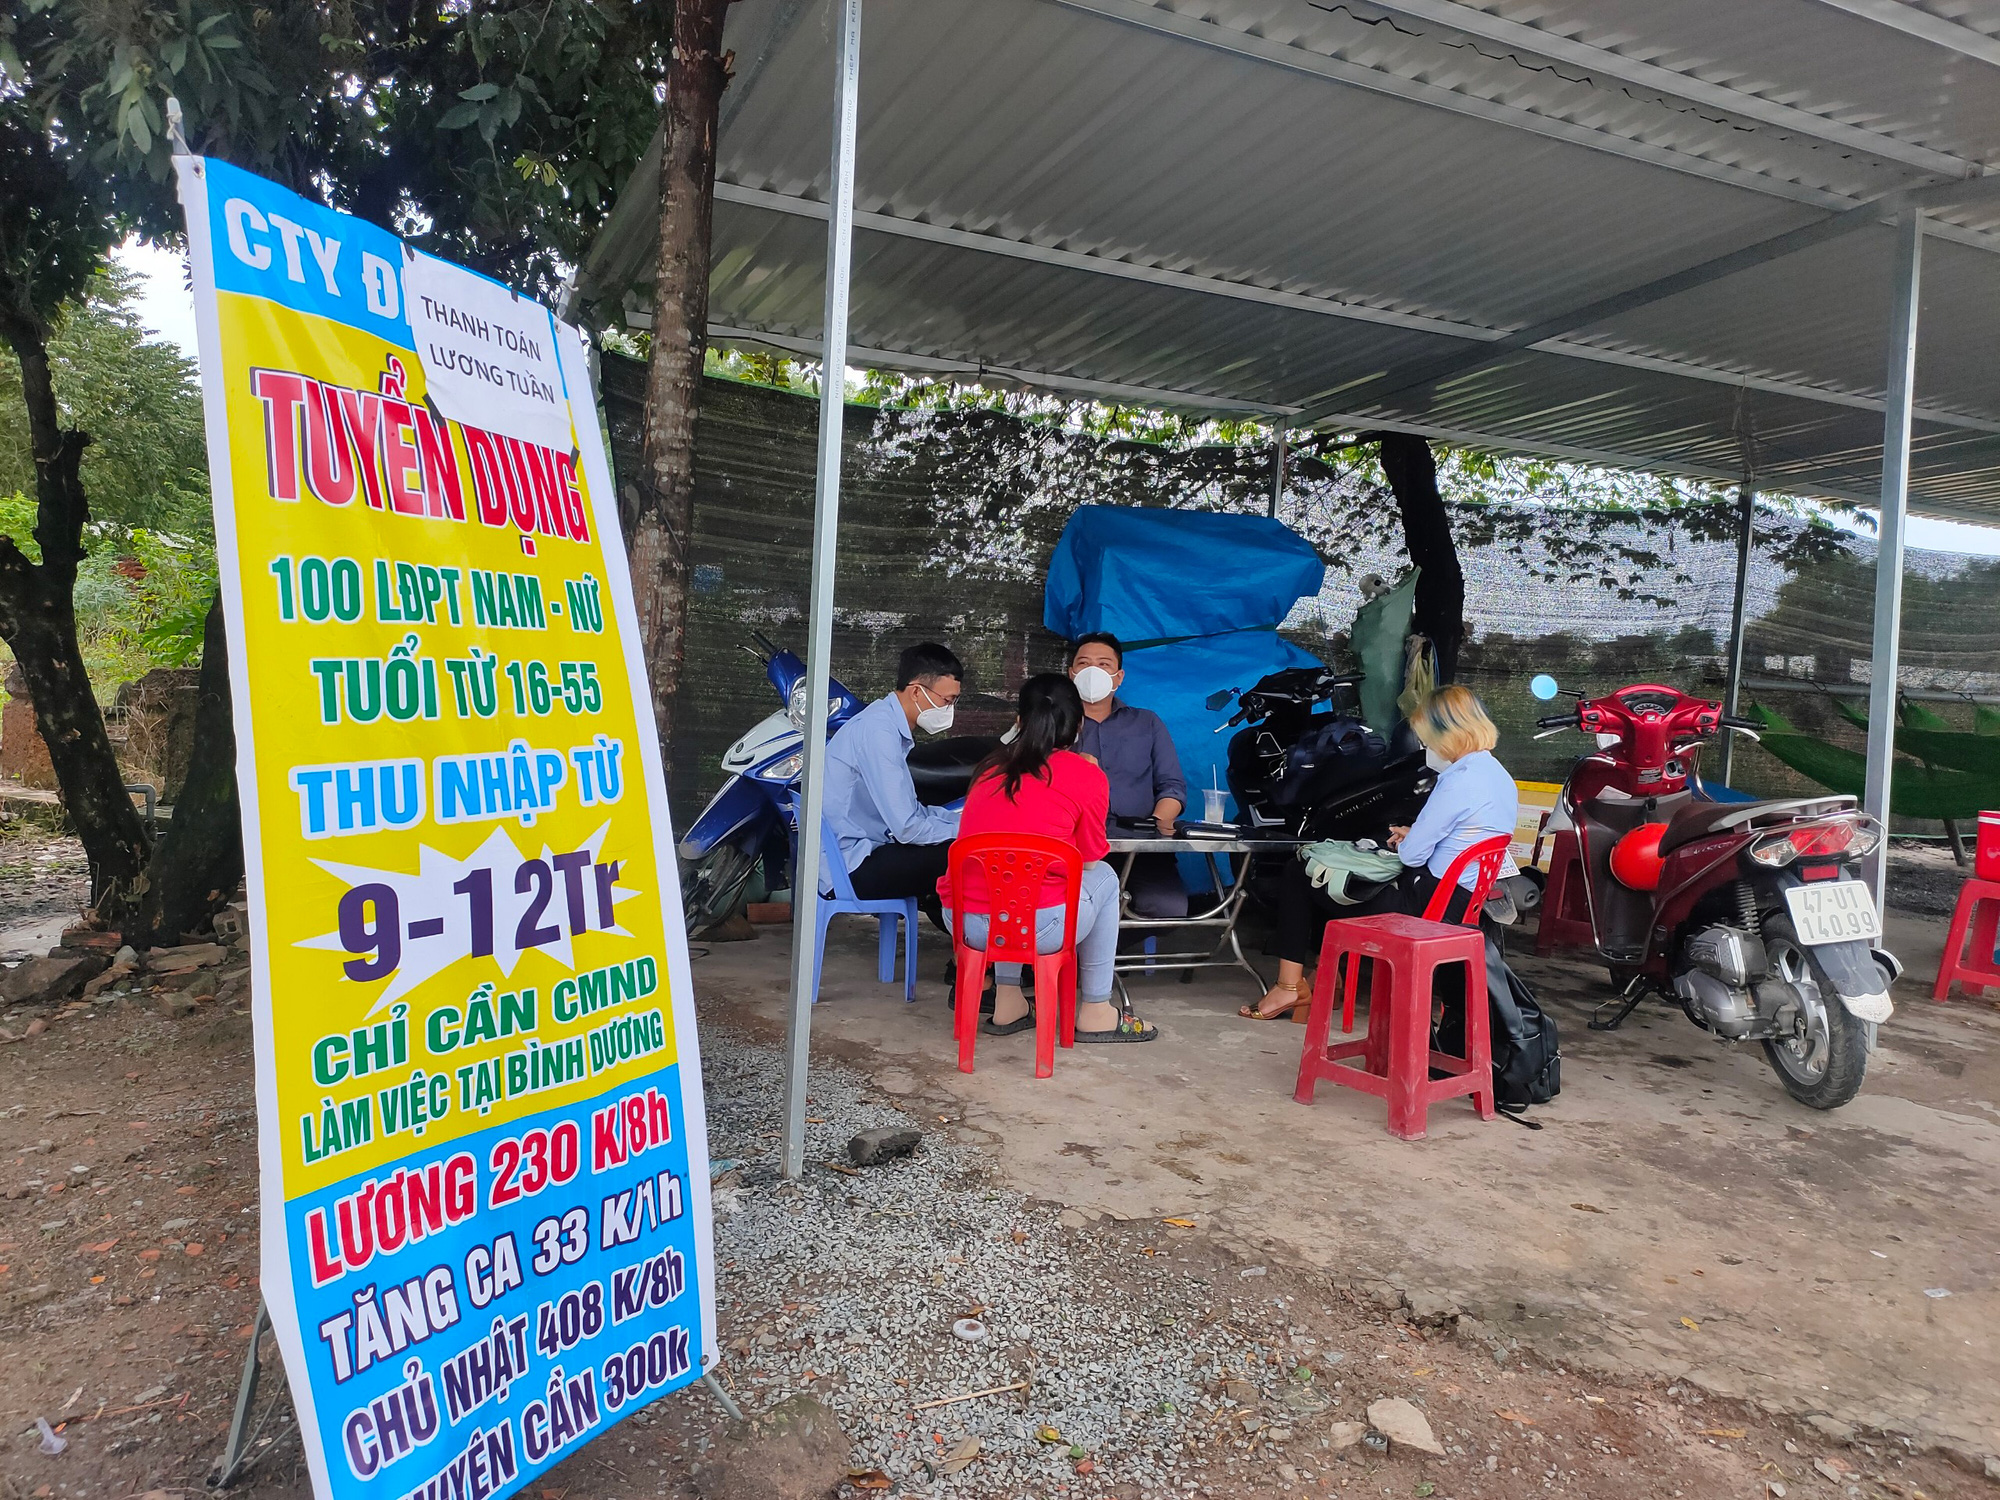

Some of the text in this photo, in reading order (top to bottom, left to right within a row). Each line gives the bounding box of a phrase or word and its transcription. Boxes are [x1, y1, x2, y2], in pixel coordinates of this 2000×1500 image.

[224, 198, 411, 326] CTY Đ
[421, 295, 542, 362] THANH TOÁN
[429, 343, 556, 405] LƯƠNG TUẦN
[250, 352, 592, 557] TUYỂN DỤNG
[270, 556, 362, 622] 100
[375, 559, 461, 626] LĐPT
[471, 569, 546, 631] NAM
[565, 573, 604, 634] NỮ
[311, 633, 603, 724] TUỔI TỪ 16-55
[291, 736, 622, 837] THU NHẬP TỪ
[1802, 910, 1876, 940] 140.99
[312, 956, 658, 1087] CHỈ CẦN CMND
[301, 1010, 665, 1165] LÀM VIỆC TẠI BÌNH DƯƠNG
[304, 1087, 672, 1289] LƯƠNG 230 K/8h
[320, 1169, 684, 1385] TĂNG CA 33 K/1h
[342, 1246, 685, 1482] CHỦ NHẬT 408 K/8h
[521, 1364, 601, 1464] CẦN
[602, 1324, 690, 1413] 300k
